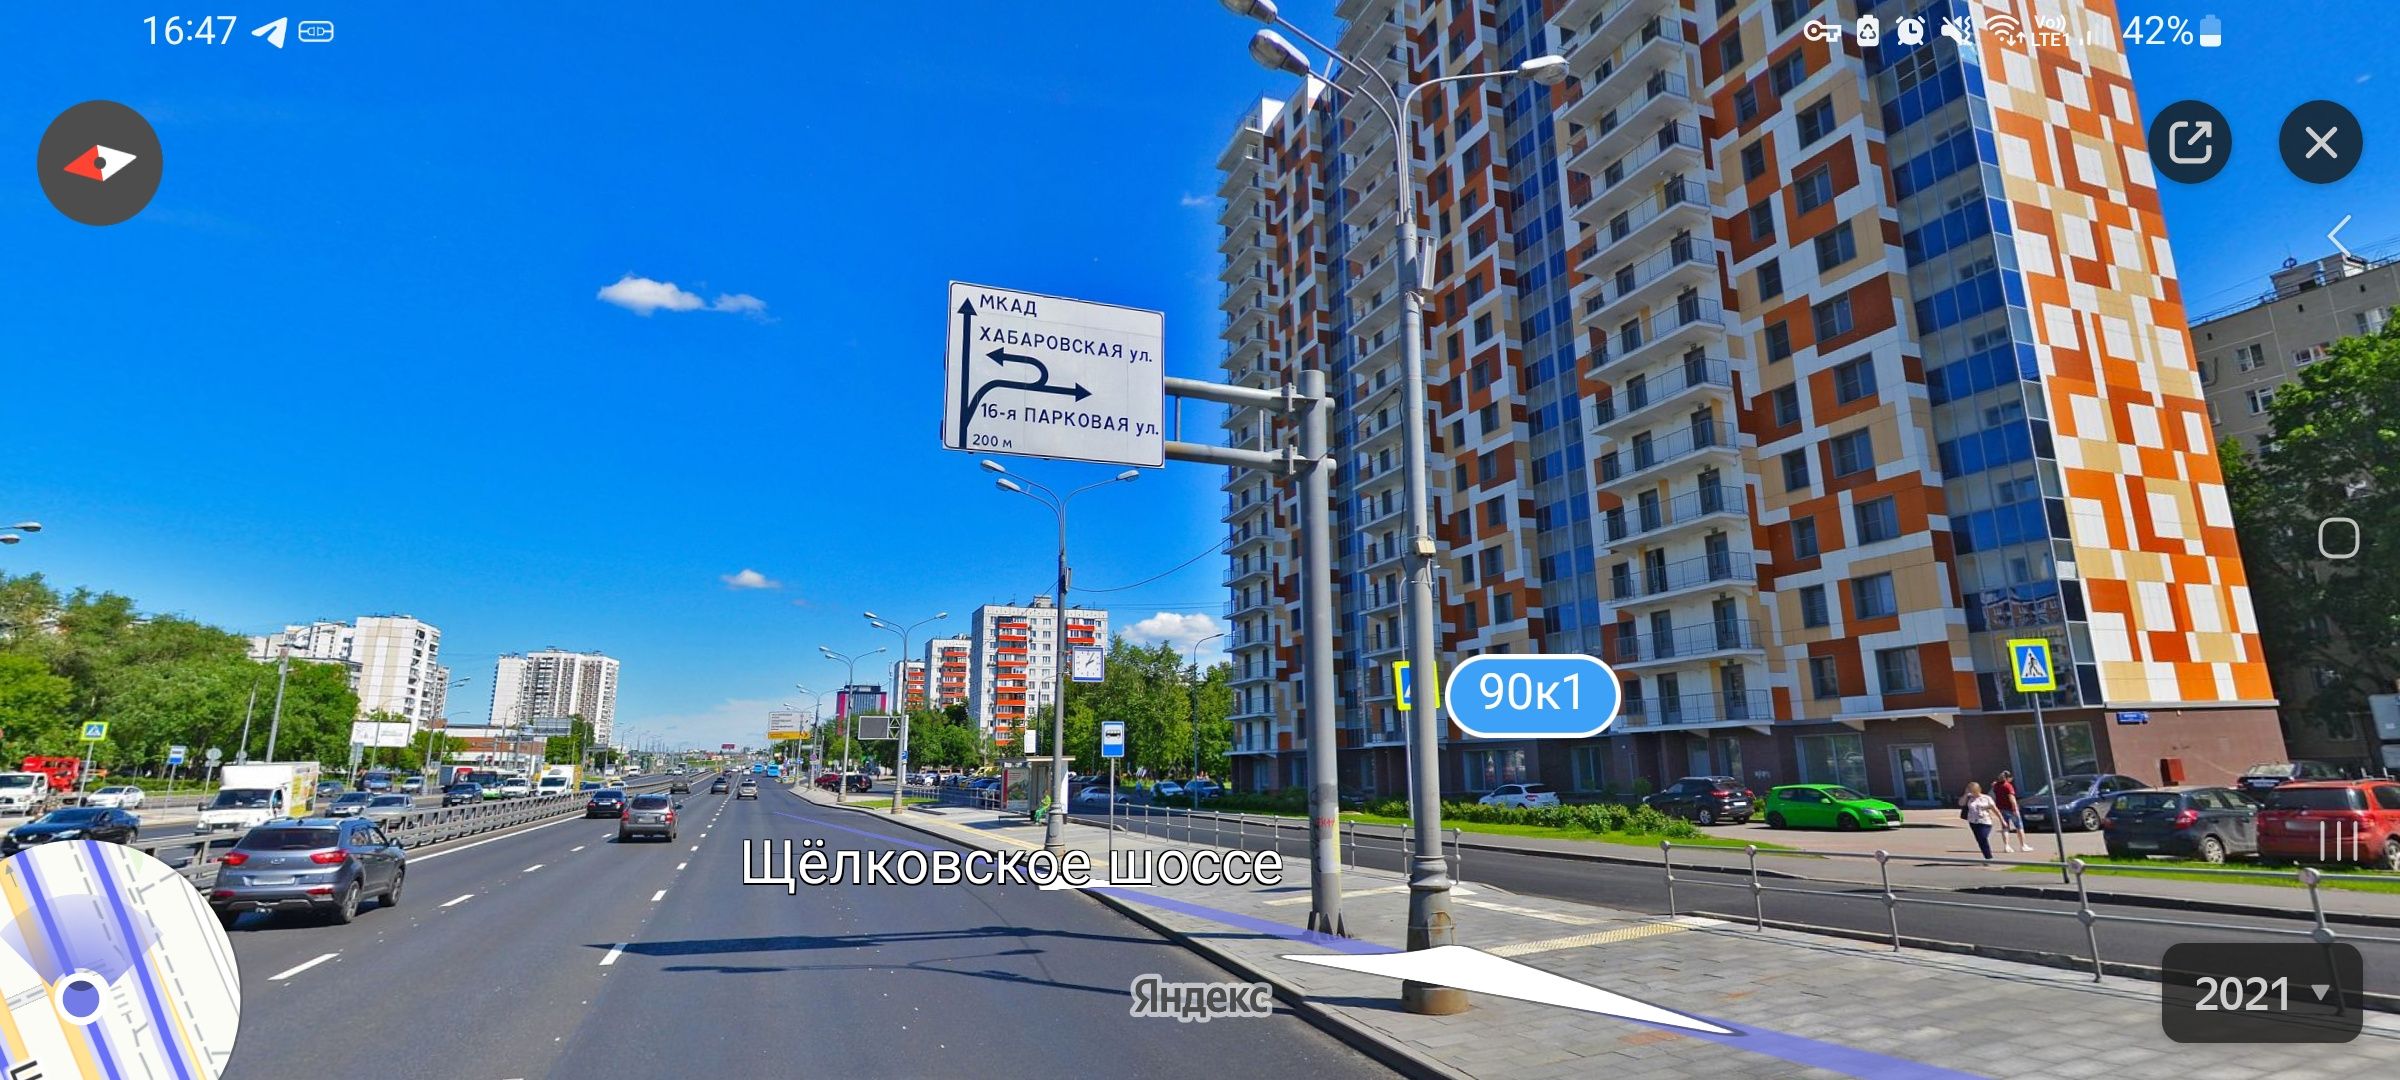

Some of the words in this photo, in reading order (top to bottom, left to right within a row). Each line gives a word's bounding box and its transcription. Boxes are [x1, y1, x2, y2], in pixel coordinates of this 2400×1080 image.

[979, 293, 1037, 317] МКАД
[979, 326, 1123, 359] ХАБАРОВСКАЯ
[1129, 349, 1153, 364] ул.
[981, 403, 1017, 421] 16-я
[1024, 407, 1129, 432] ПАРКОВАЯ
[1135, 421, 1159, 437] ул.
[972, 434, 998, 447] 200
[1002, 439, 1012, 449] м
